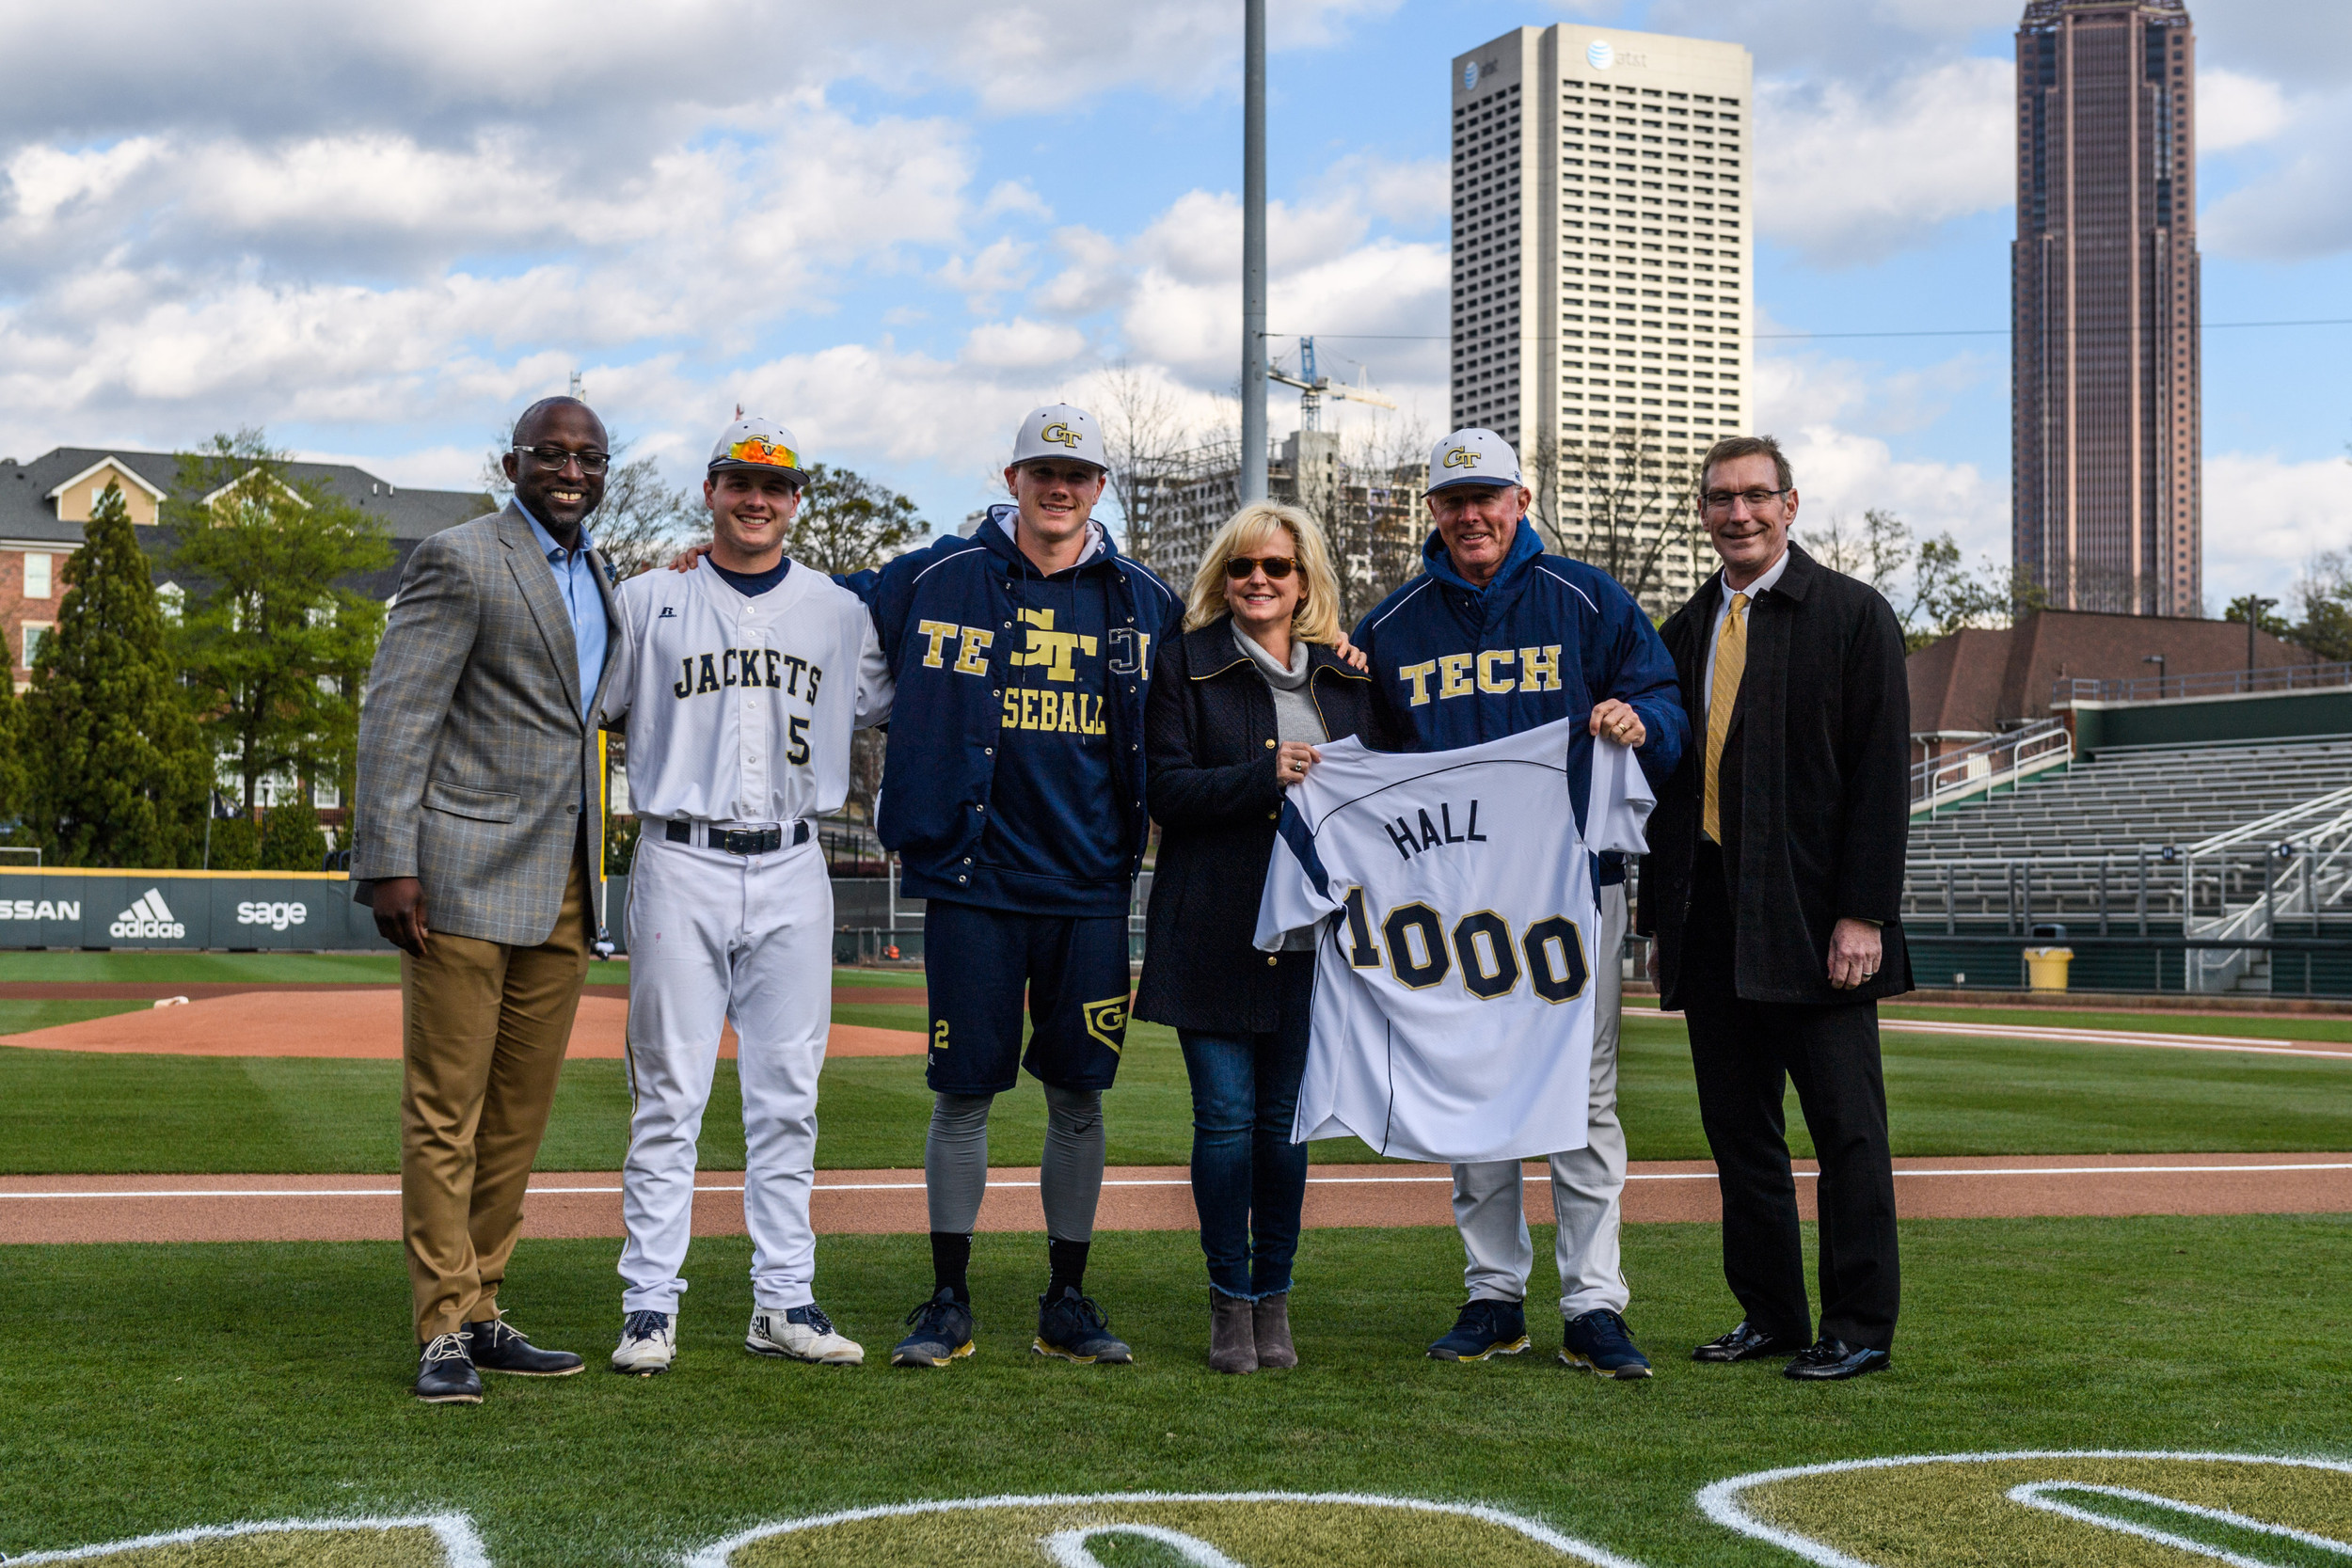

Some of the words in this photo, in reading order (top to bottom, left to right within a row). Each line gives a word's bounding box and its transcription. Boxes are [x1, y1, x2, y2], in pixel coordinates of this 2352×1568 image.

[674, 648, 822, 706] JACKETS
[1399, 644, 1562, 706] TECH
[786, 714, 811, 767] 5
[1384, 800, 1486, 861] HALL
[109, 919, 185, 939] adidas
[237, 901, 307, 931] sage
[1343, 886, 1590, 1006] 1000
[934, 1019, 949, 1049] 2
